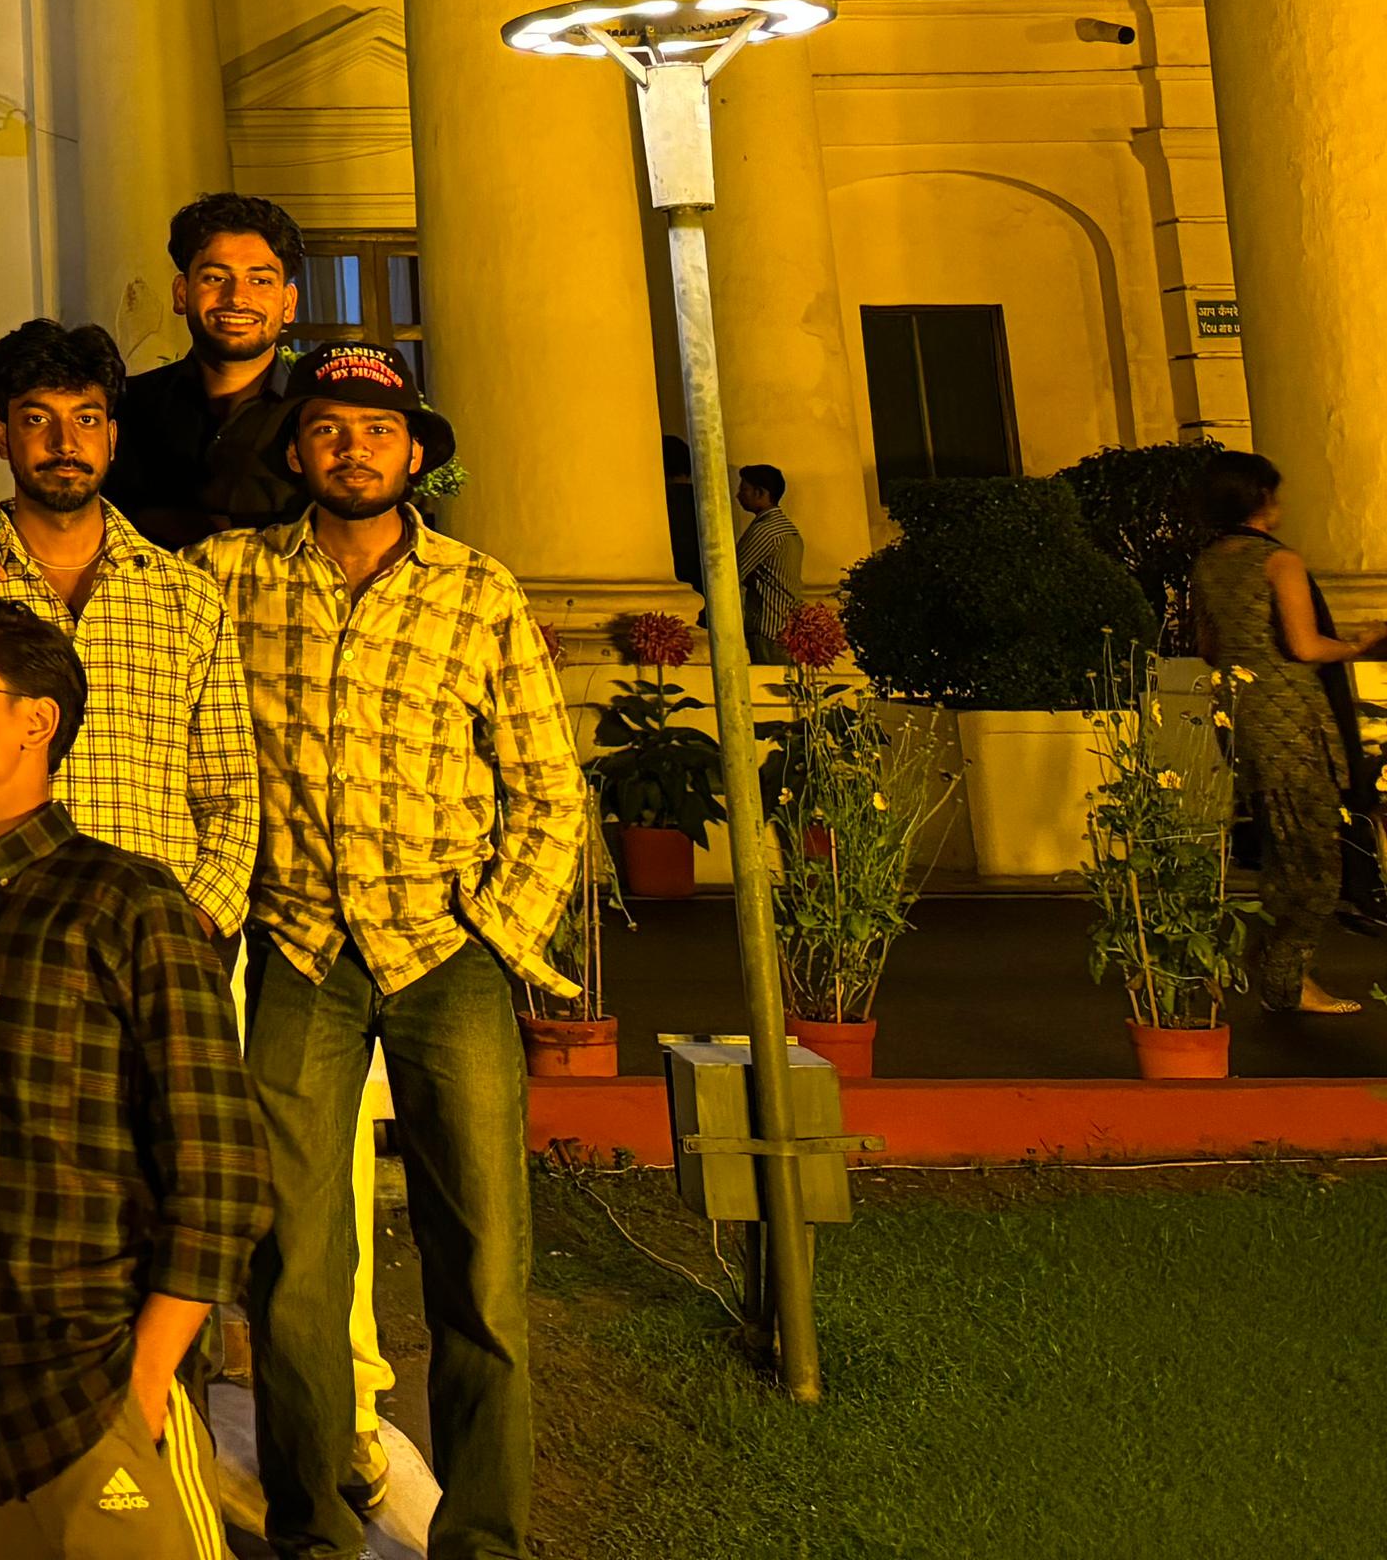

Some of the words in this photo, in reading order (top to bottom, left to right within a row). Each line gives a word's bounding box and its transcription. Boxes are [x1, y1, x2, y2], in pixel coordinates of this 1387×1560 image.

[1200, 322, 1217, 334] You
[330, 346, 387, 362] EASILY
[98, 1493, 150, 1511] adidas
